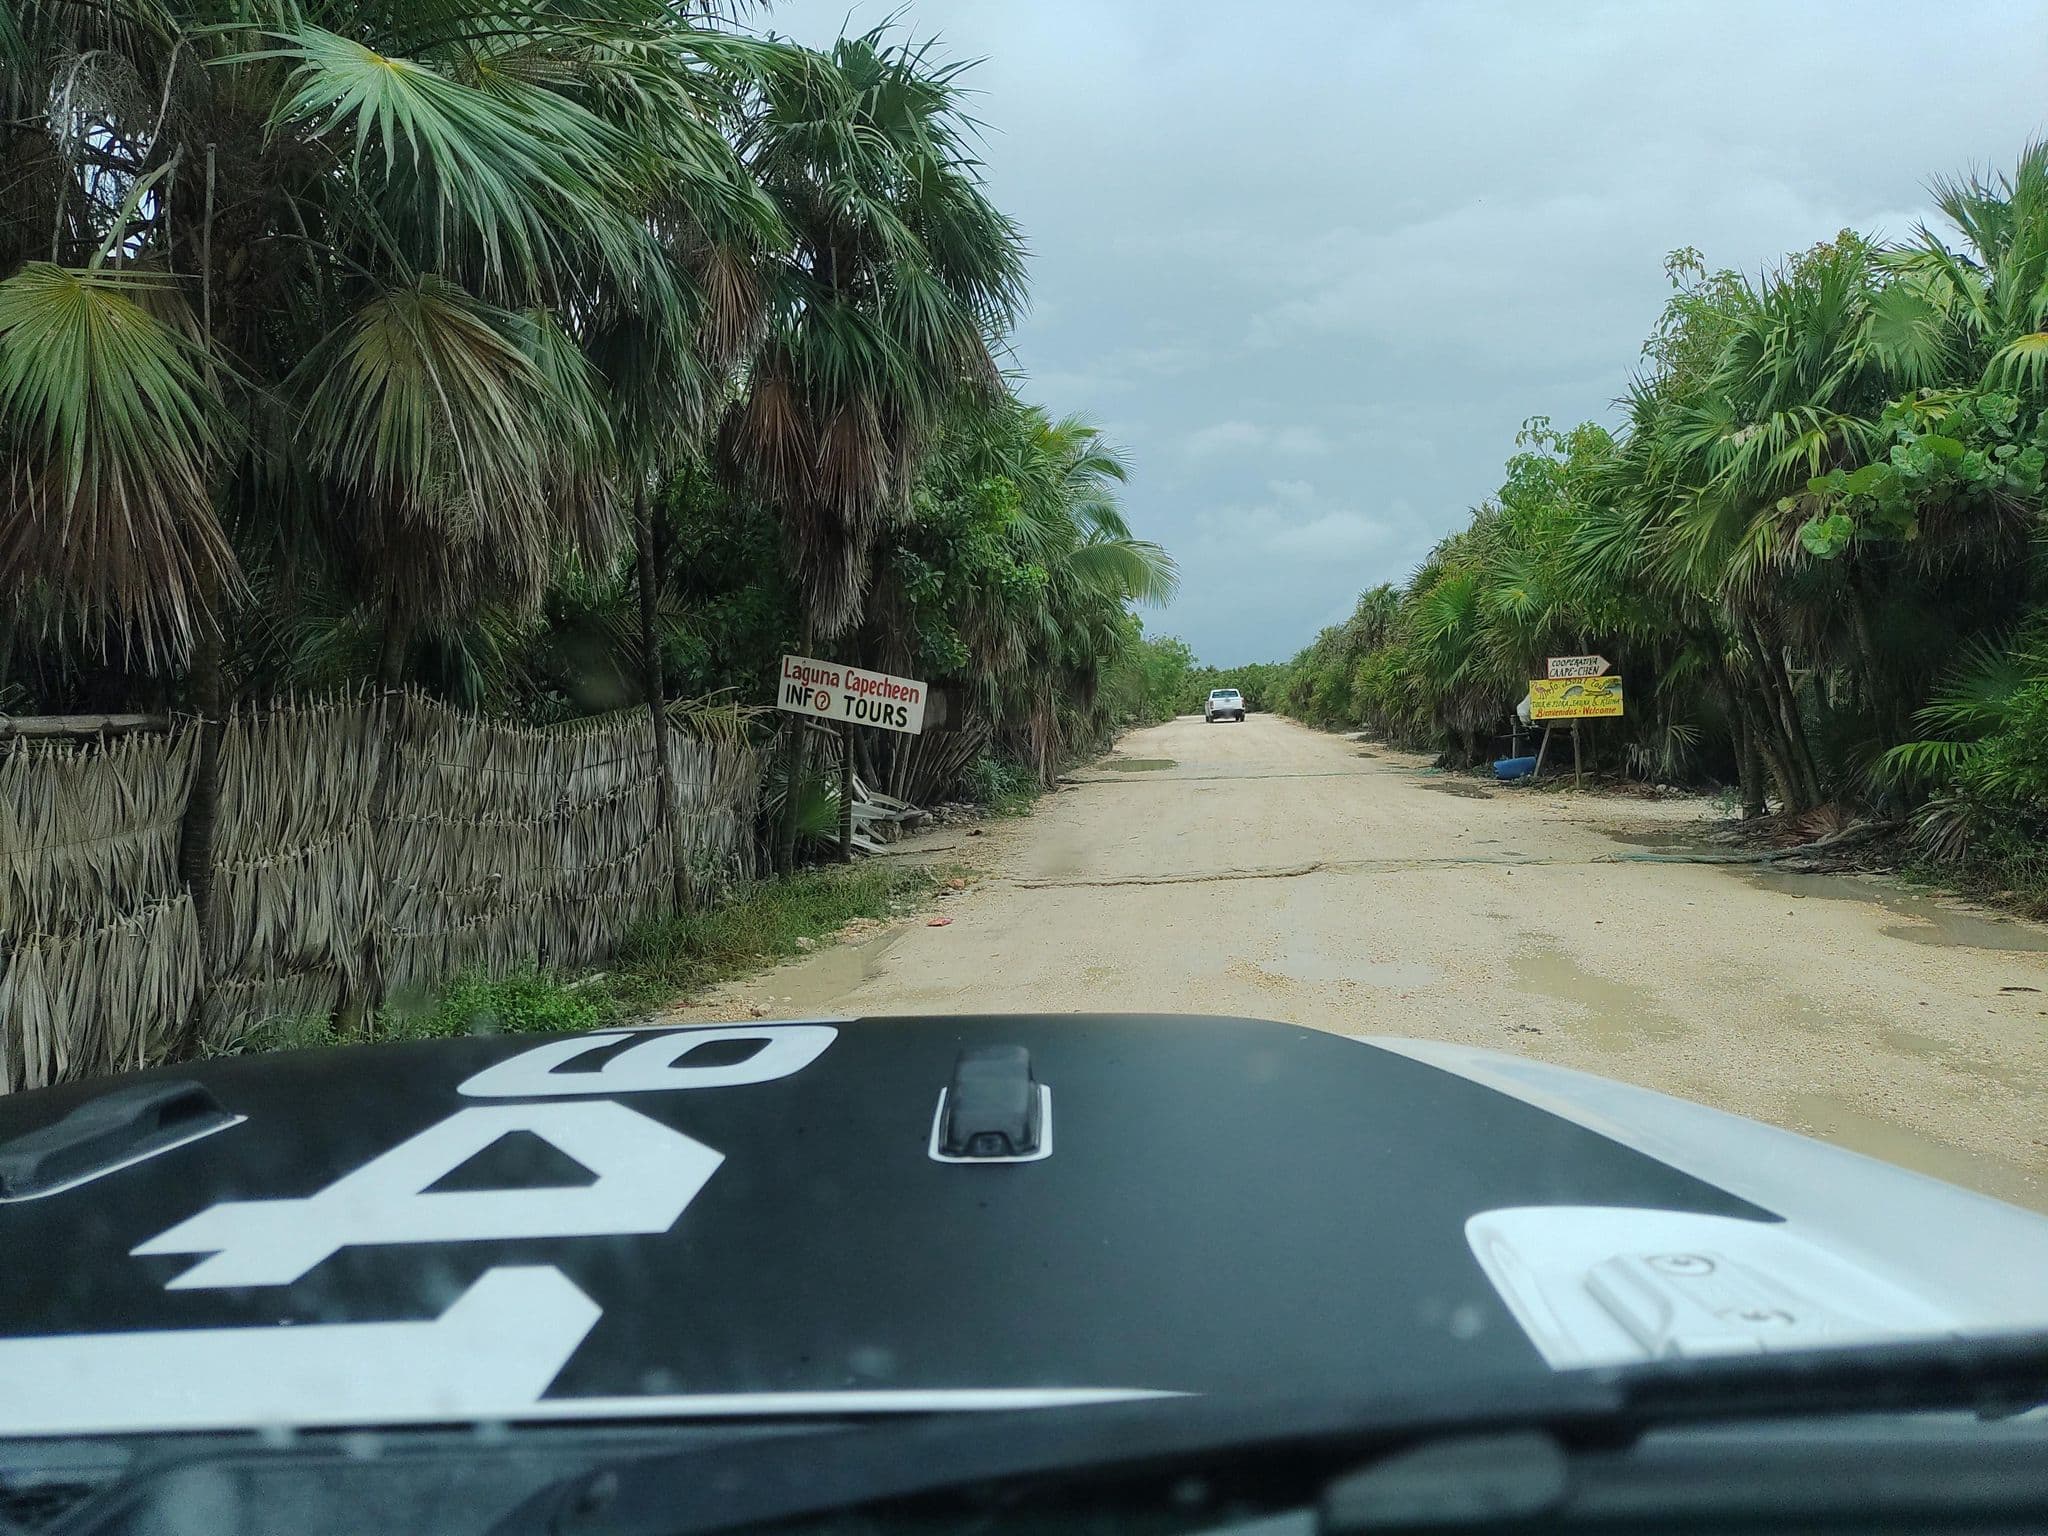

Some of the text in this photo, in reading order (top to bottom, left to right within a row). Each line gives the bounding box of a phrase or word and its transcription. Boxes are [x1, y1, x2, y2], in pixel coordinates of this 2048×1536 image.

[1552, 657, 1598, 668] COOPERATIVA
[784, 657, 920, 704] Laguna Capecheen
[843, 695, 908, 728] TOURS
[1536, 705, 1617, 718] Bienvenidos Welcome
